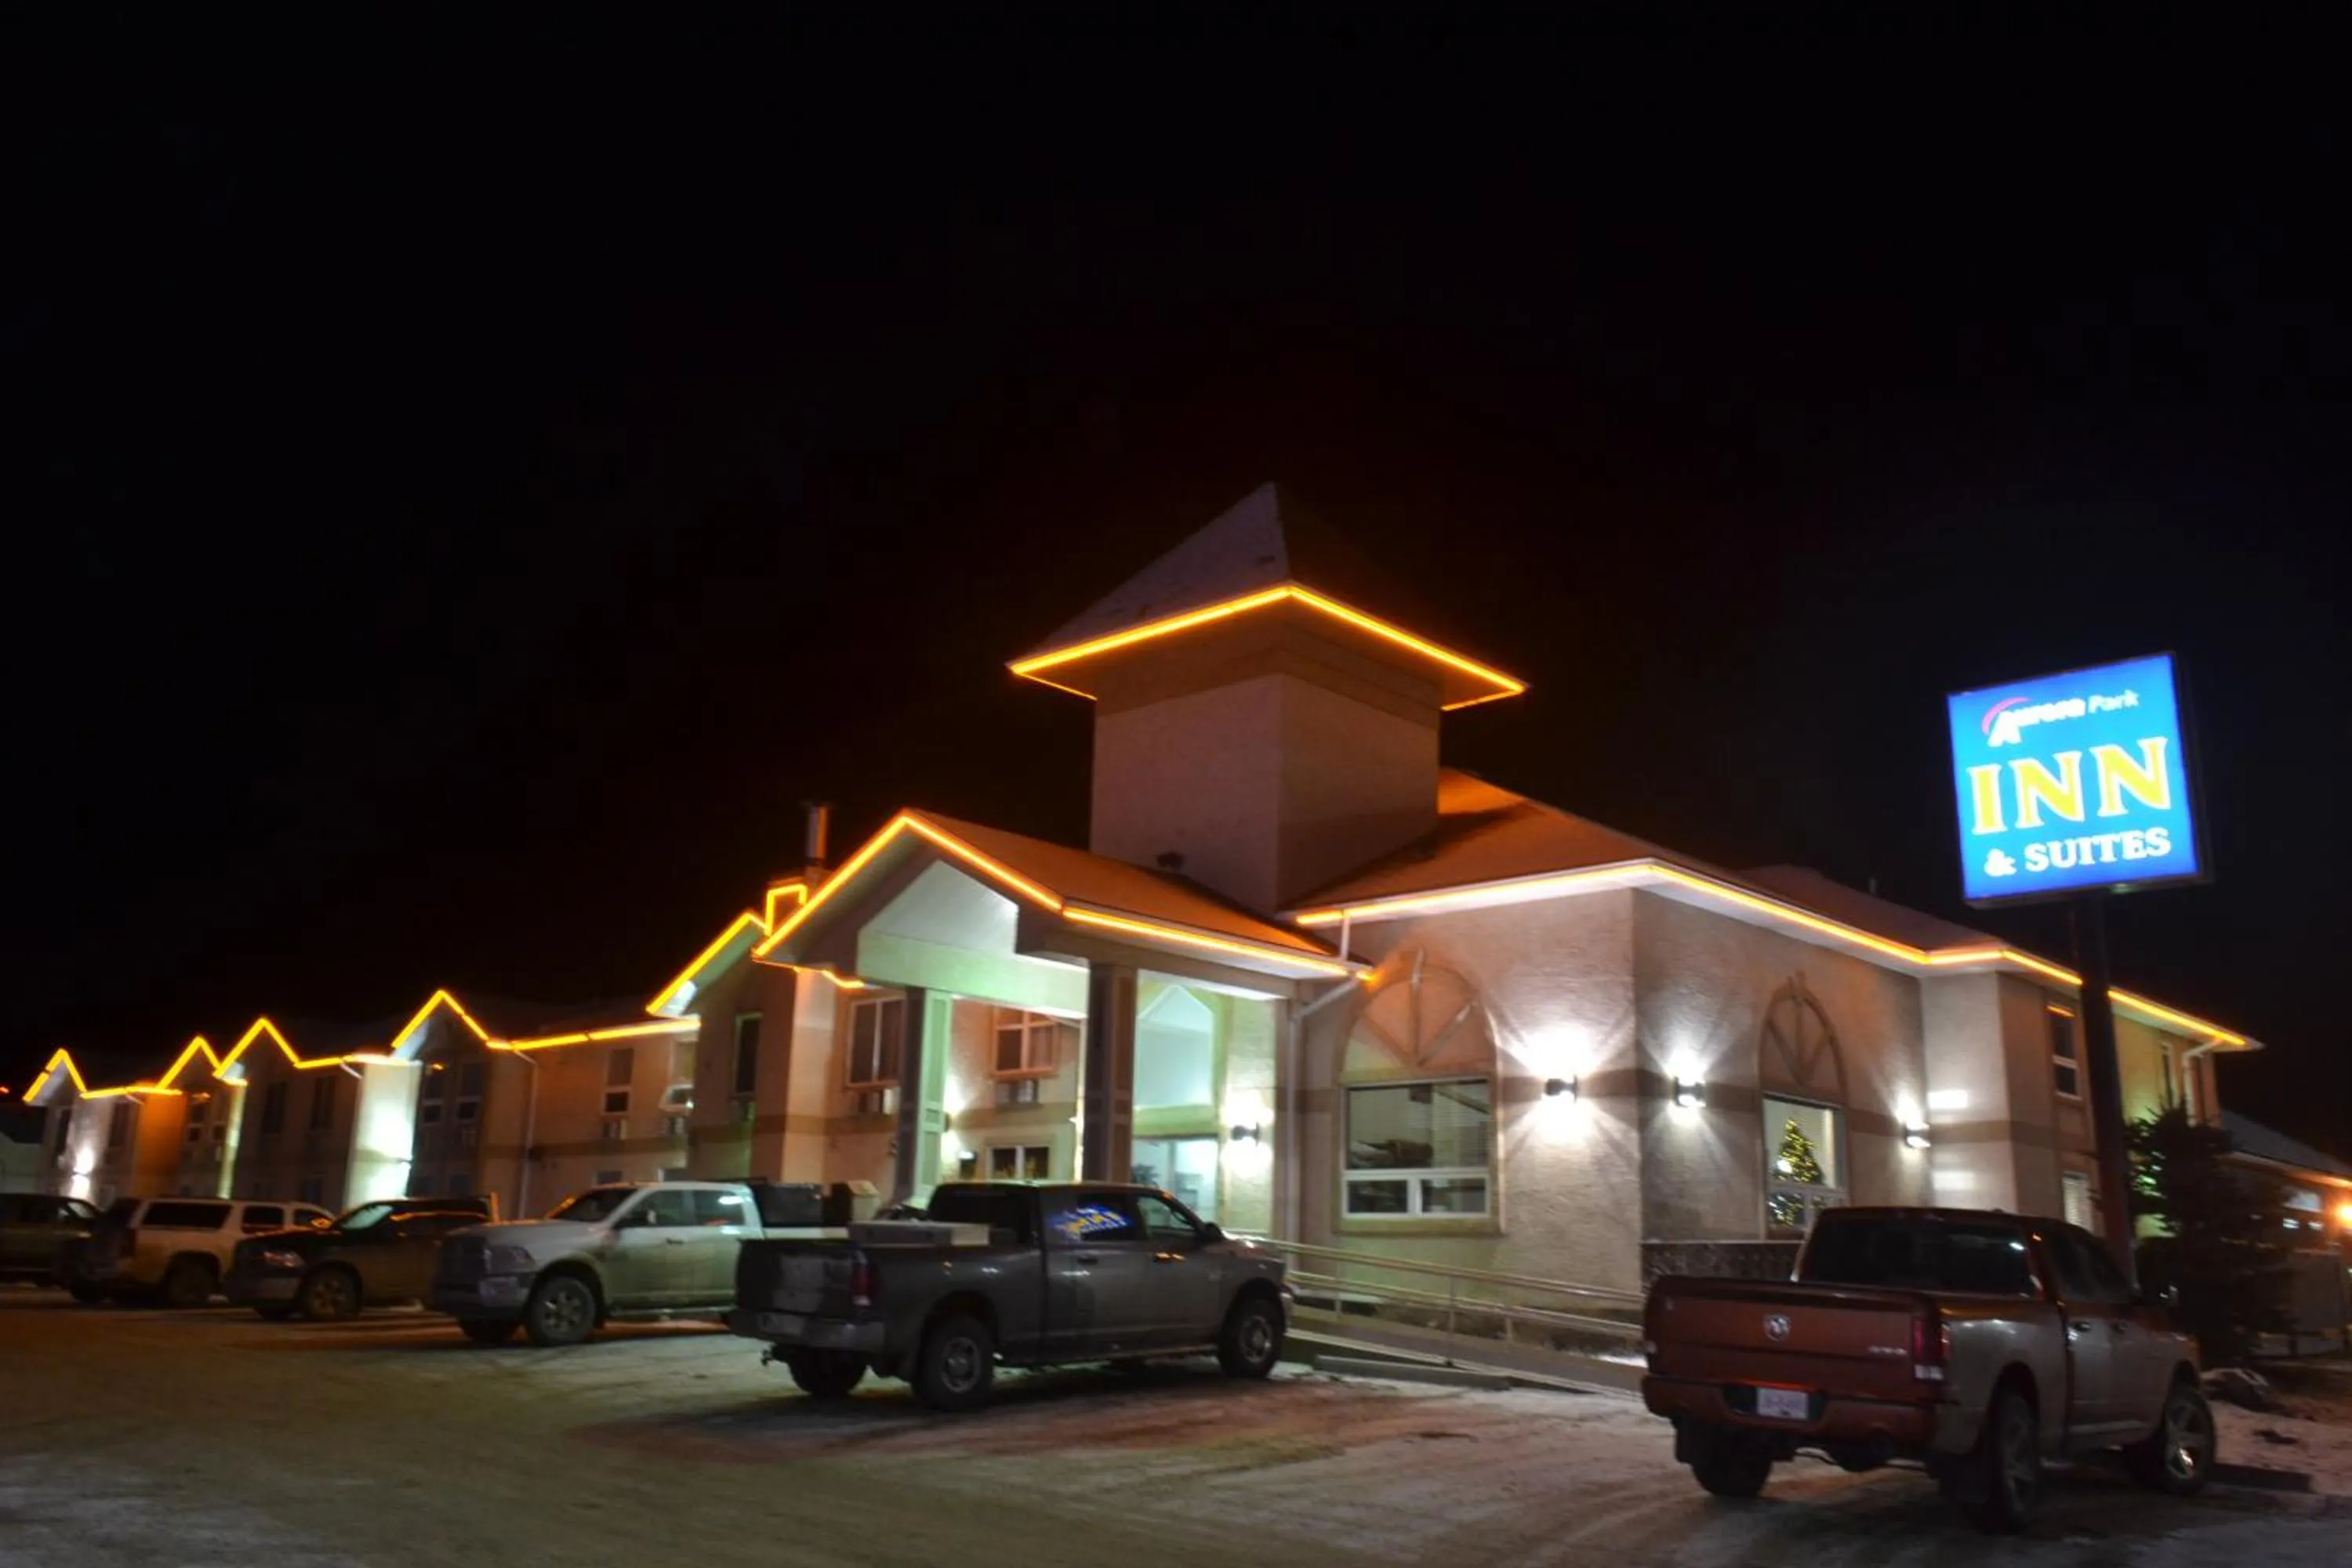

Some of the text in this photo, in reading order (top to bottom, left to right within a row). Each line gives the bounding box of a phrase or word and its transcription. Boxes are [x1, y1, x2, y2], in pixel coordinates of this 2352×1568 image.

[2088, 690, 2139, 713] Park
[1966, 736, 2171, 835] INN
[1984, 827, 2171, 877] & SUITES
